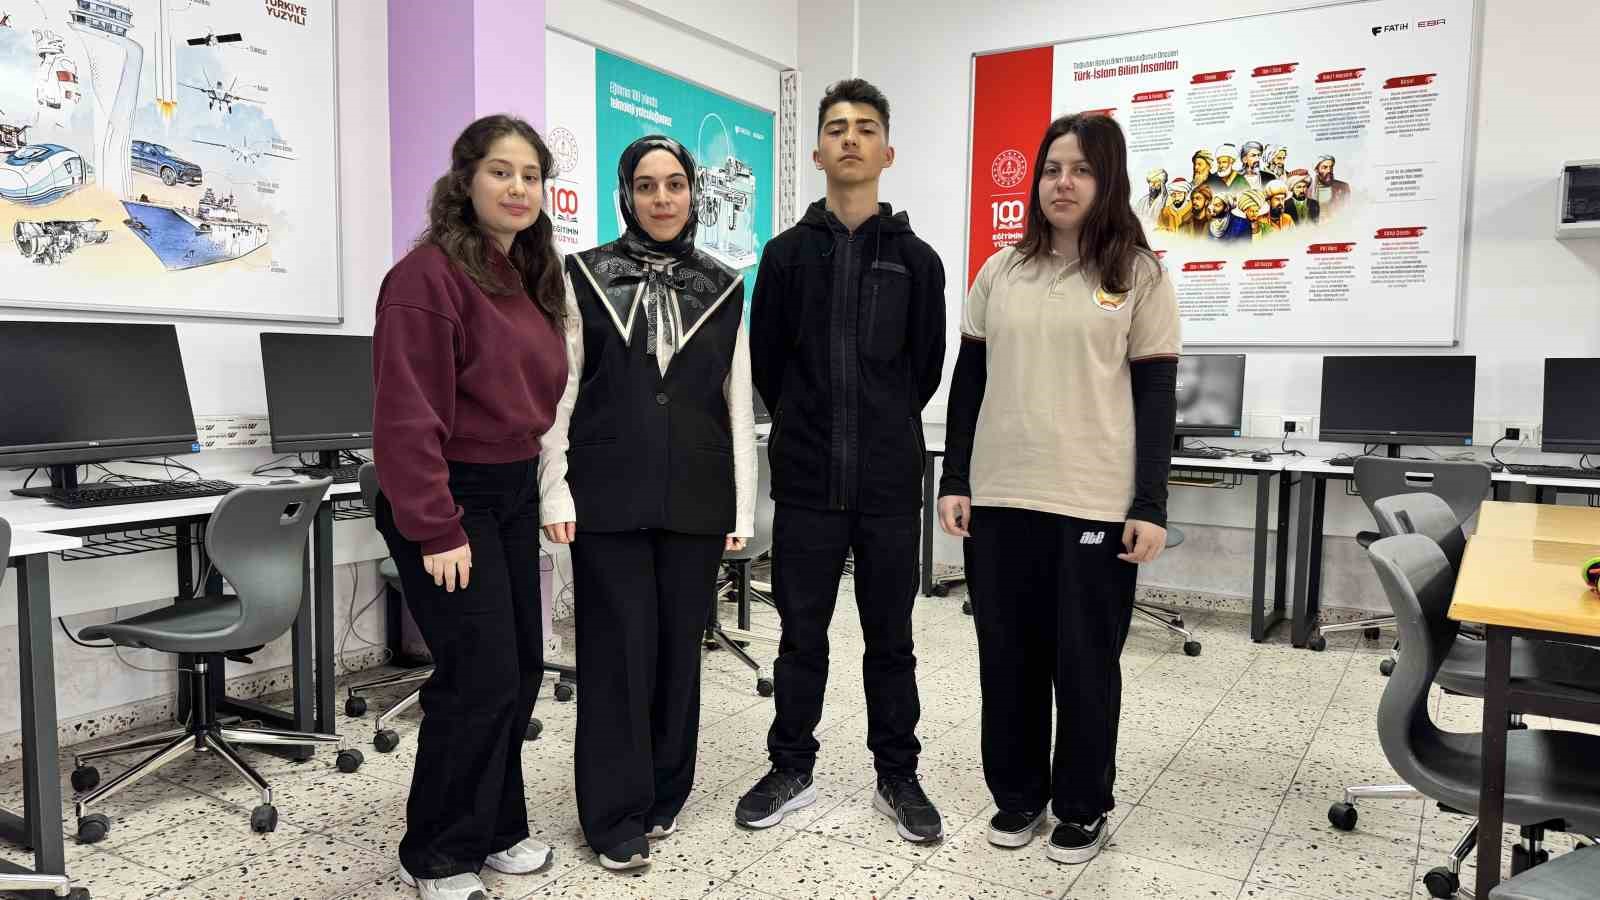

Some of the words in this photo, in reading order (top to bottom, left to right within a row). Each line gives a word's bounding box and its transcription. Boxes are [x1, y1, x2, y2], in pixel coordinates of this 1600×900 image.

[1073, 66, 1117, 82] Türk-İslam
[1118, 64, 1139, 77] Bilim
[1140, 59, 1179, 74] İnsanları
[550, 186, 578, 217] 100
[991, 199, 1024, 230] 100
